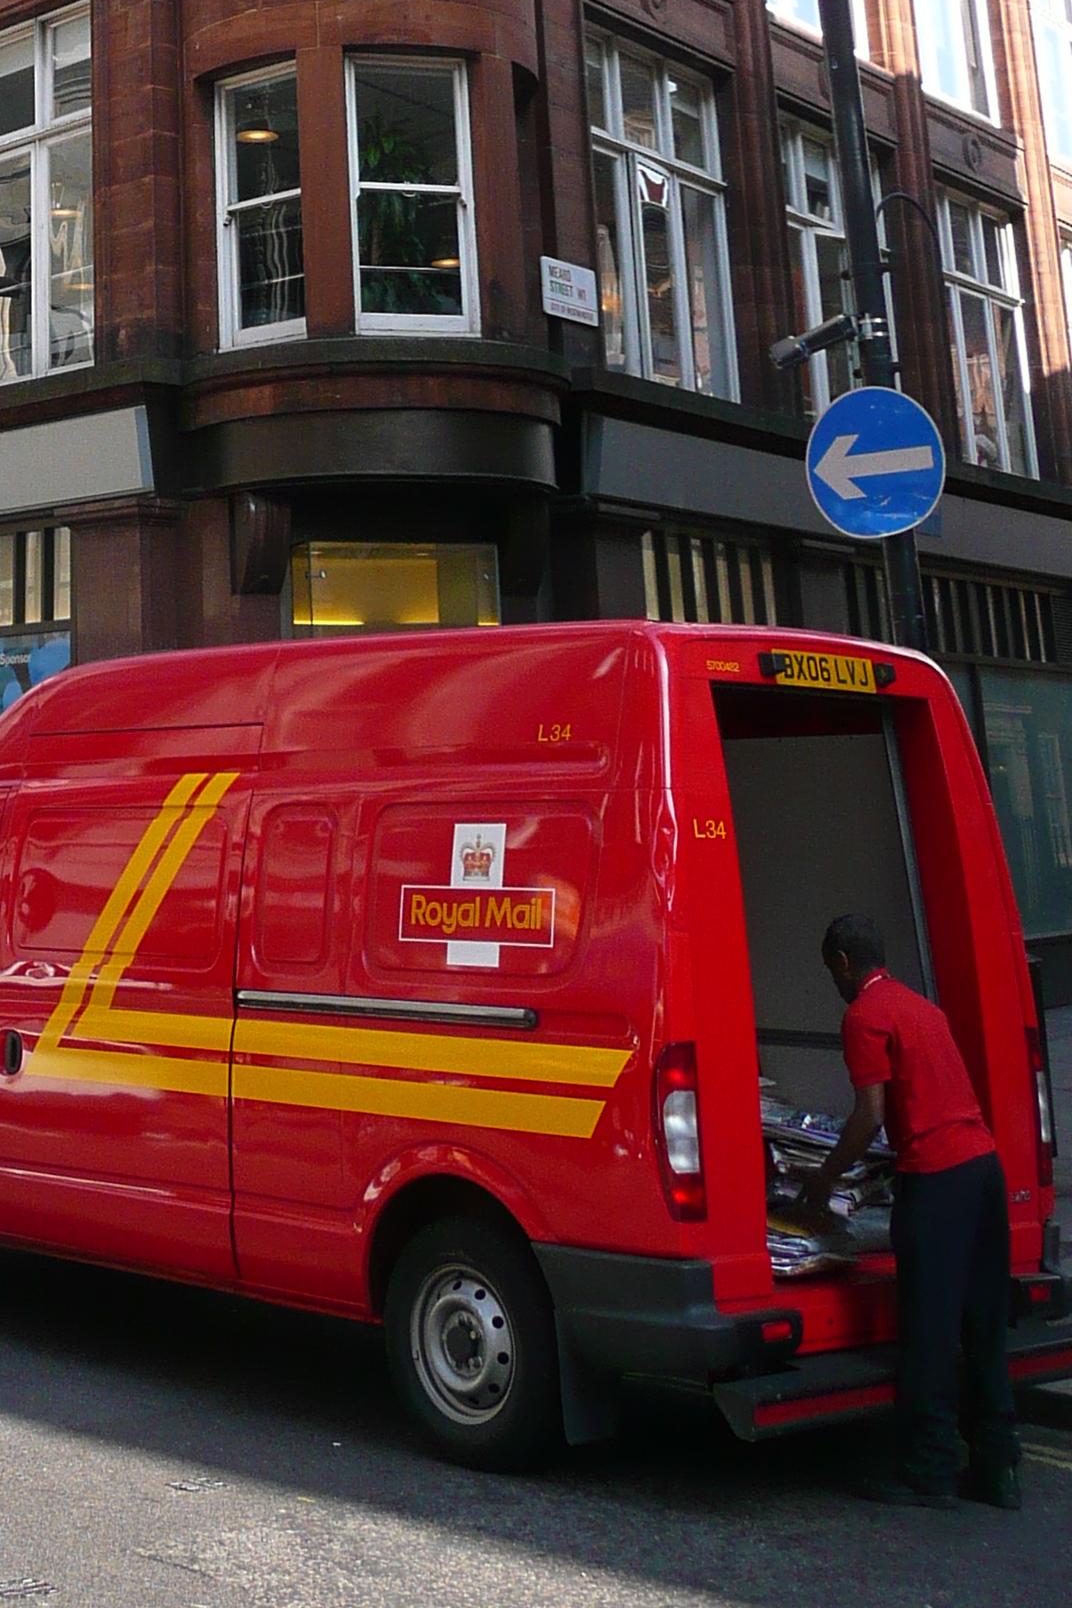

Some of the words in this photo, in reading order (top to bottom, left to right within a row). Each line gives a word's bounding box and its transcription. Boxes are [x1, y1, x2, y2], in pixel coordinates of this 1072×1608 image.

[549, 280, 574, 298] STREET
[0, 652, 31, 668] Sponsor
[784, 653, 831, 683] BX06
[834, 658, 870, 687] LVJ
[538, 724, 572, 741] L34
[693, 818, 727, 839] L34
[411, 894, 480, 934] Royal
[484, 896, 542, 930] Mail
